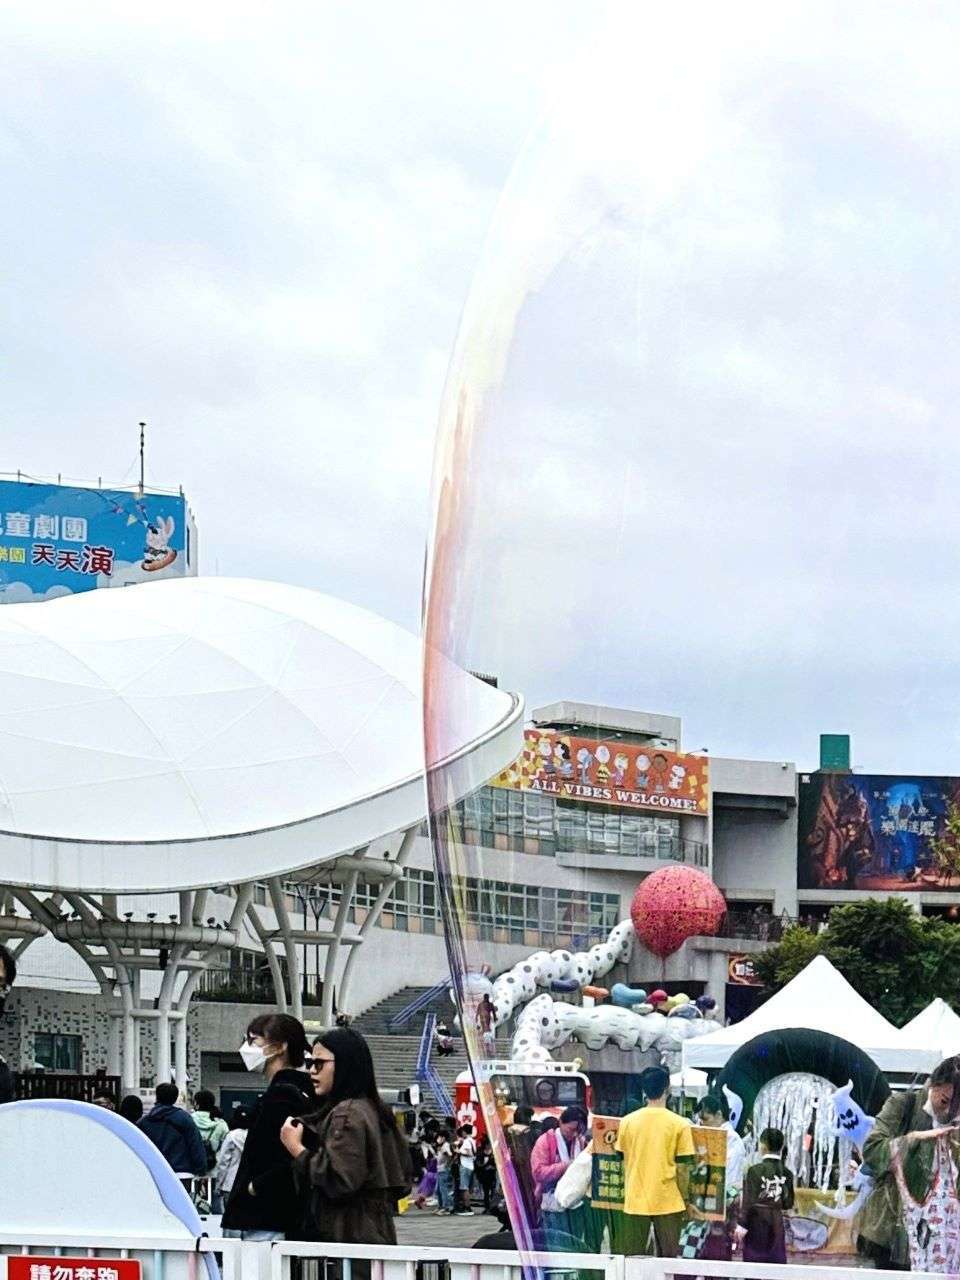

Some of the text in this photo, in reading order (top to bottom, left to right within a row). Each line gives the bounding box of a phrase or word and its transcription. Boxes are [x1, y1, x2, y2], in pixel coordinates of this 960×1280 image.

[0, 511, 87, 542] 童劇團
[33, 543, 114, 576] 天天演
[532, 780, 560, 793] ALL
[564, 783, 612, 800] VIBES
